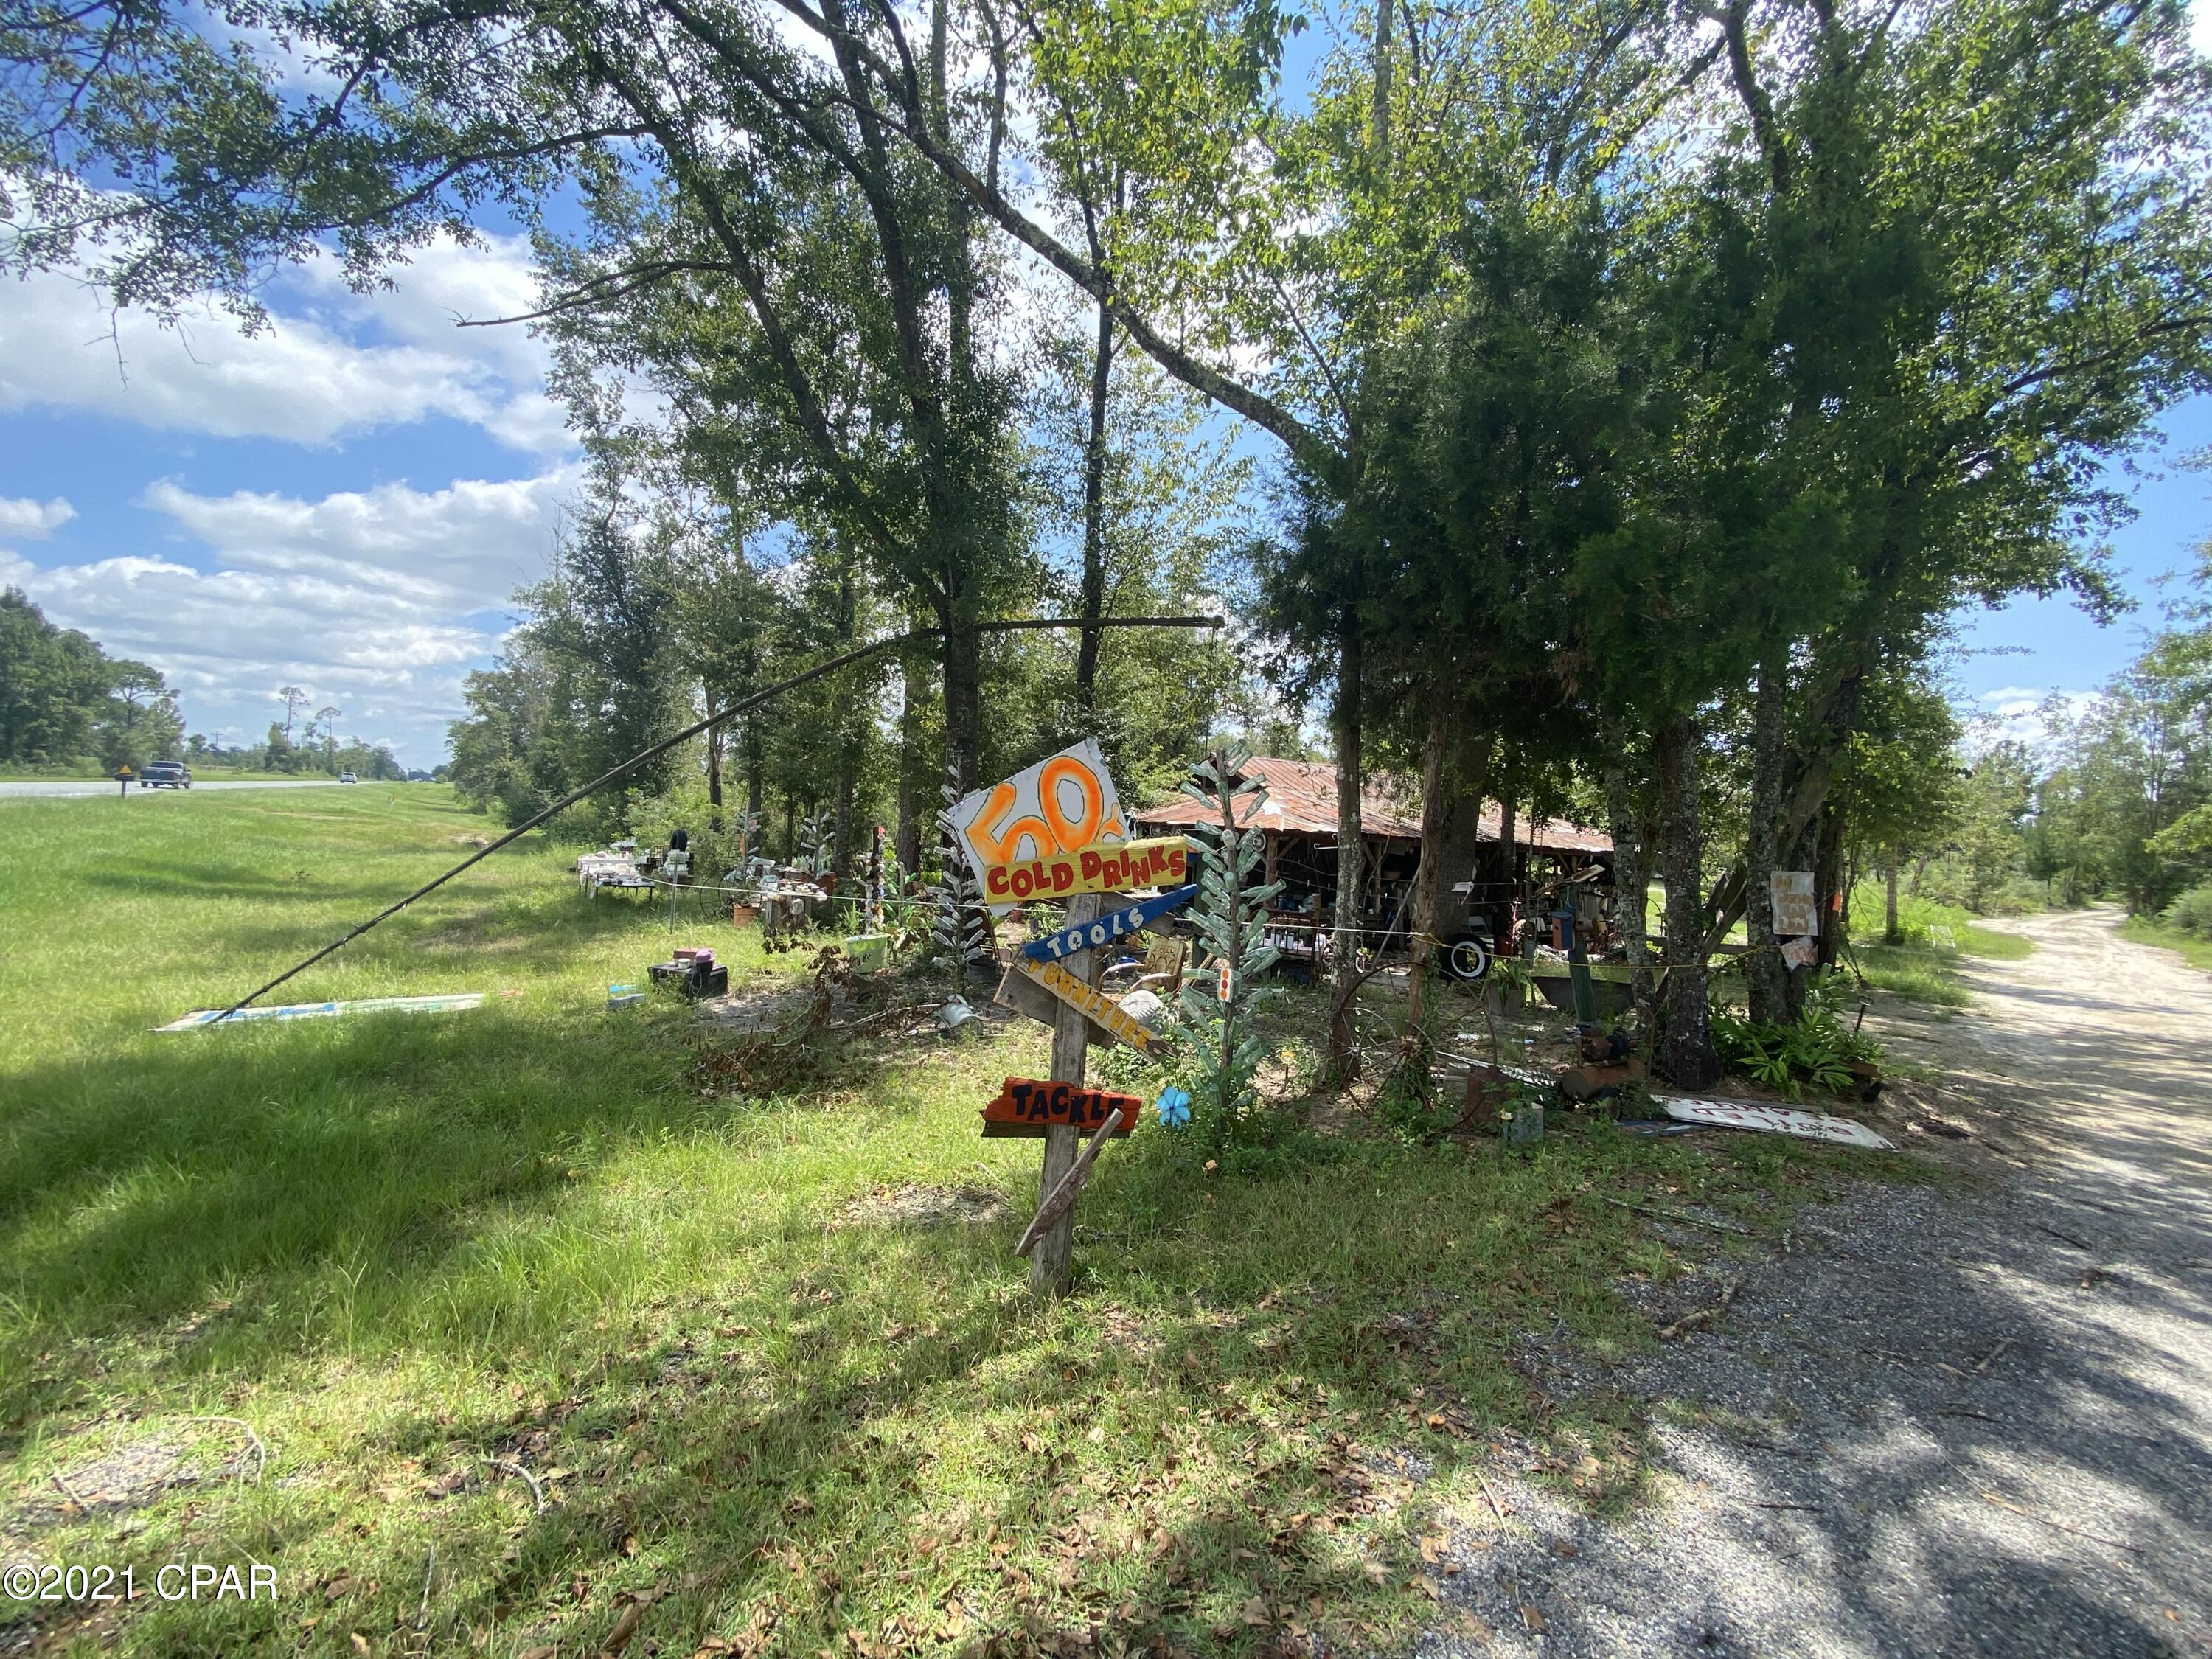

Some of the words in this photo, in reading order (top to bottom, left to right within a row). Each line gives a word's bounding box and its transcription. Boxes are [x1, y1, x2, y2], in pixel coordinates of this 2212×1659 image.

[987, 861, 1074, 897] COLD
[1079, 845, 1185, 888] DRINKS
[1046, 908, 1145, 958] TOOLS
[1028, 959, 1152, 1051] FURNITURE
[1012, 1084, 1125, 1124] TACKLE
